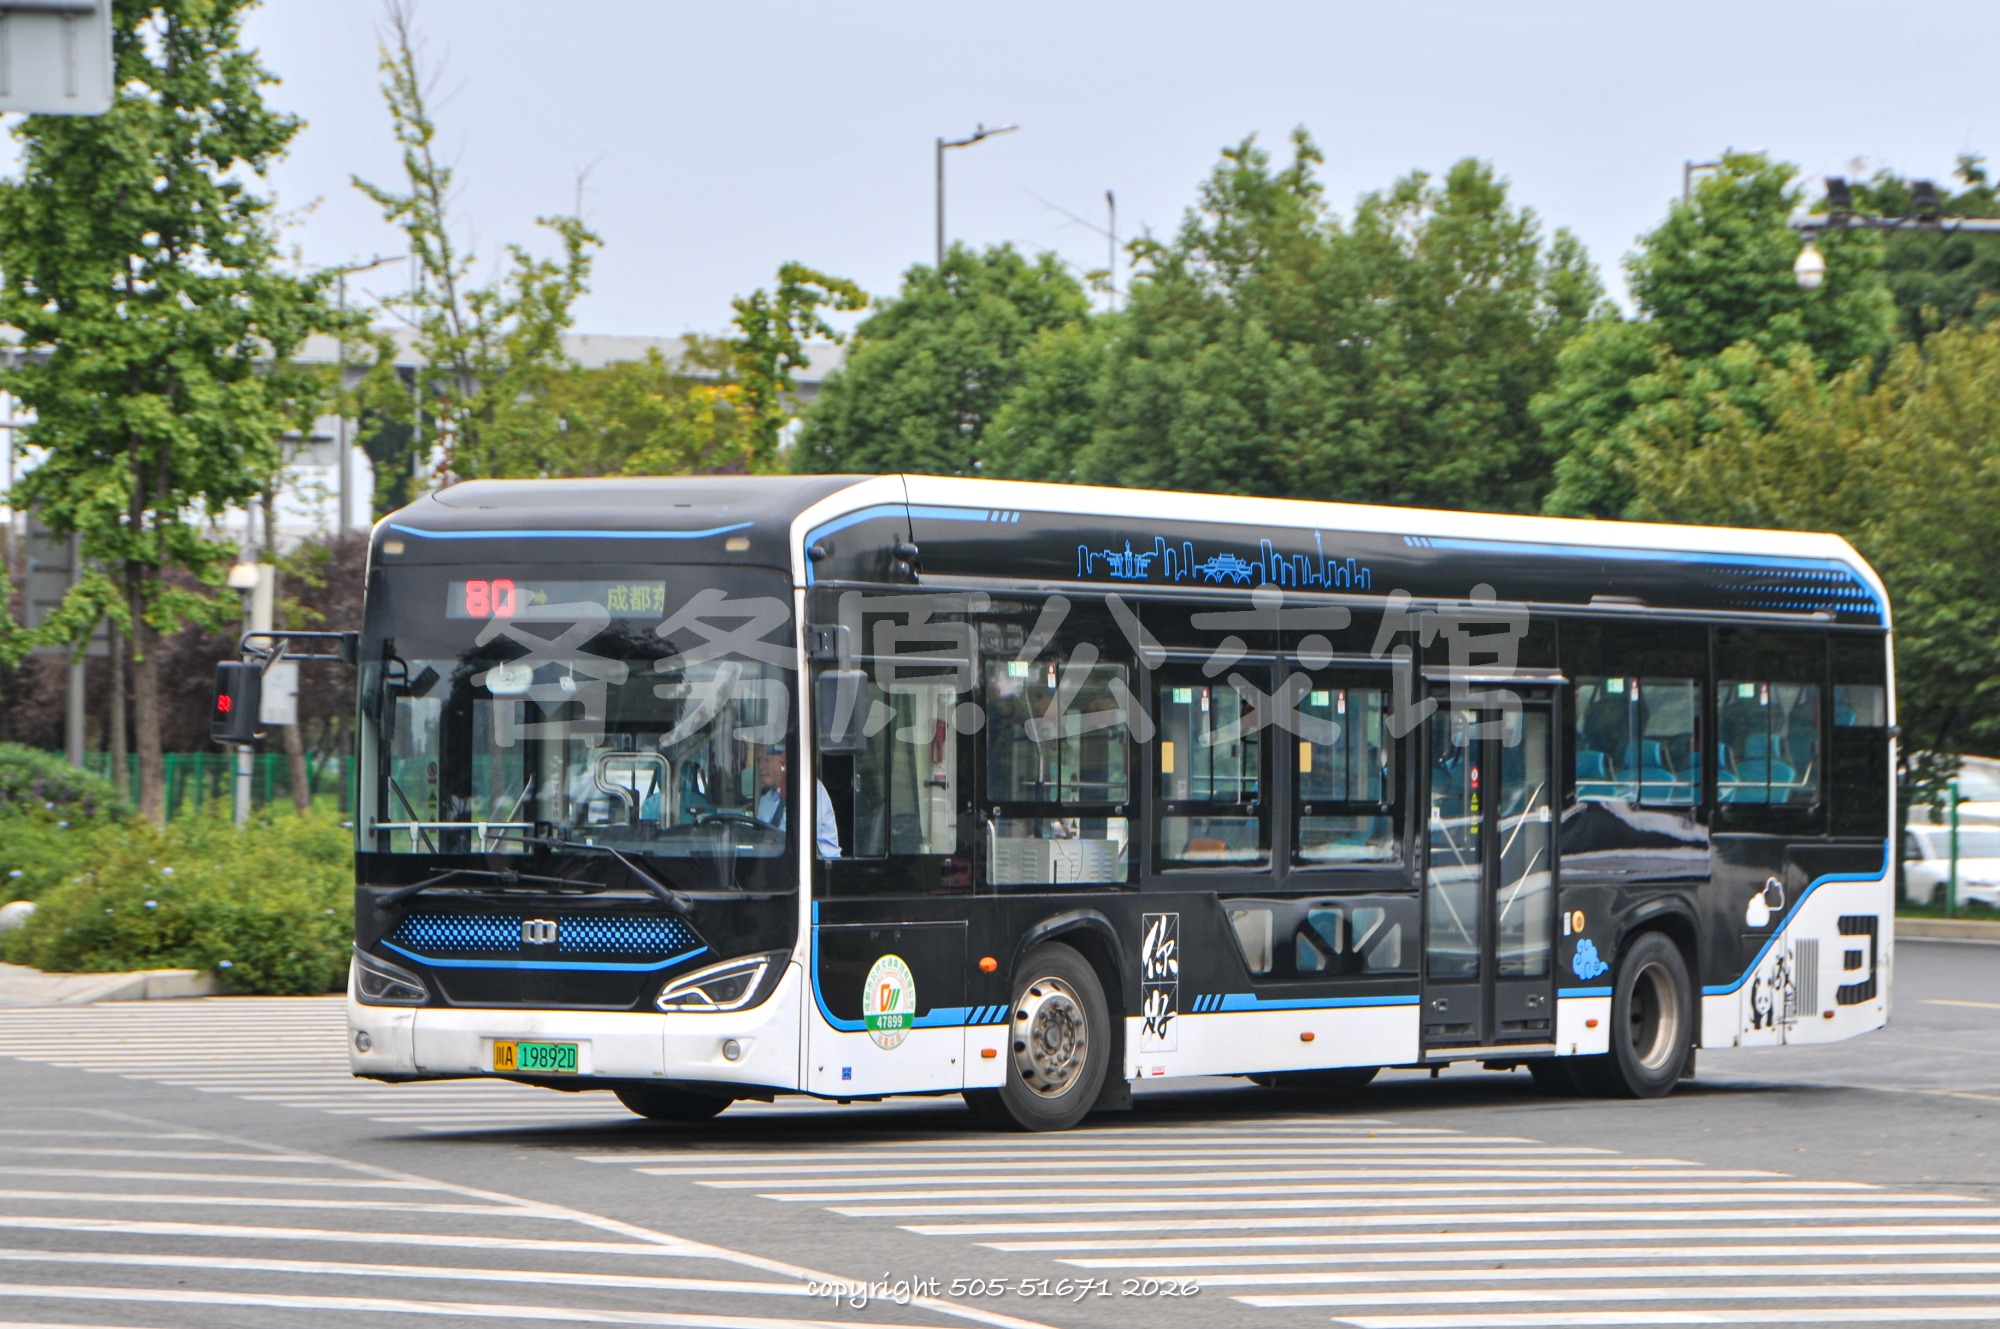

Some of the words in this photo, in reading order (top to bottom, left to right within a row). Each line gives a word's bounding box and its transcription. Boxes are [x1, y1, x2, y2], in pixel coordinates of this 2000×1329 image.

[465, 579, 516, 617] 80
[1142, 914, 1178, 1040] 你好
[876, 1014, 903, 1030] 47899
